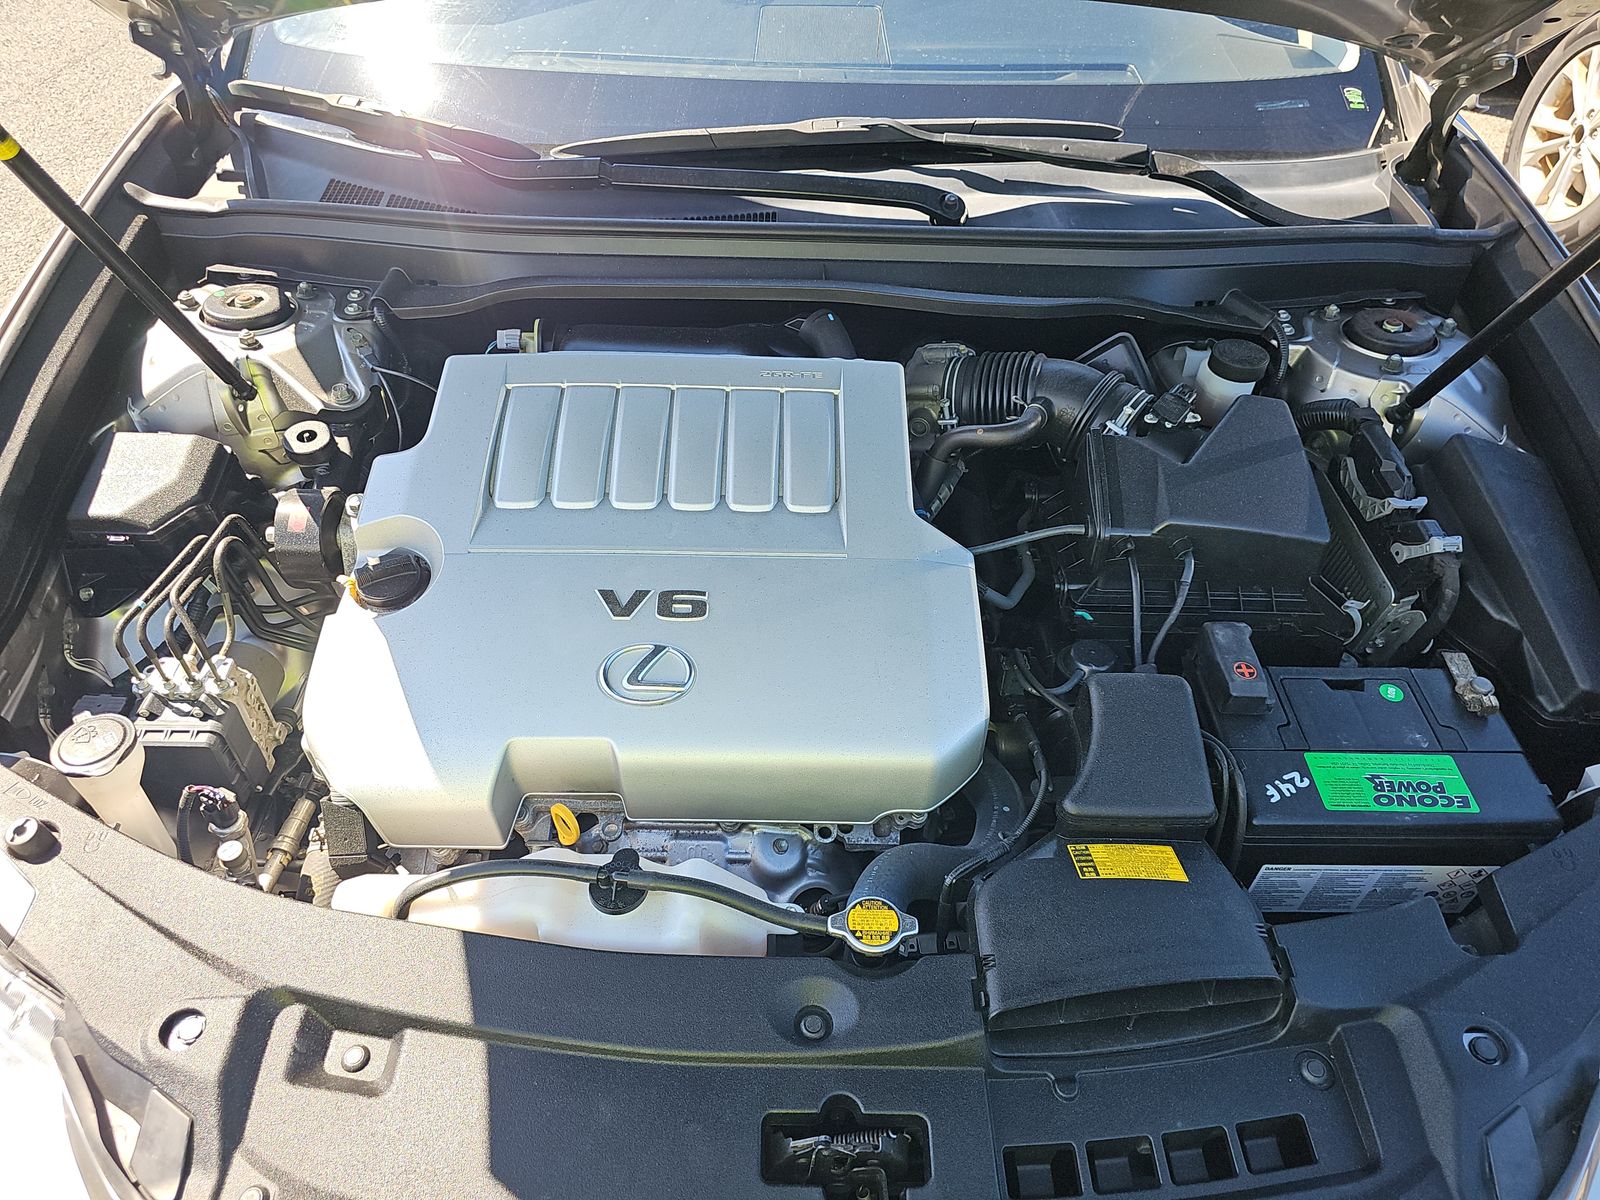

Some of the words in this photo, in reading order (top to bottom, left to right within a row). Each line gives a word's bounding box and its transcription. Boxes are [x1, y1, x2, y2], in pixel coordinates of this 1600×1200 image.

[759, 370, 824, 379] 2GR-FE
[594, 588, 710, 622] V6
[1265, 770, 1311, 804] 24F
[1371, 778, 1446, 795] POWER
[1372, 793, 1472, 810] ECONO
